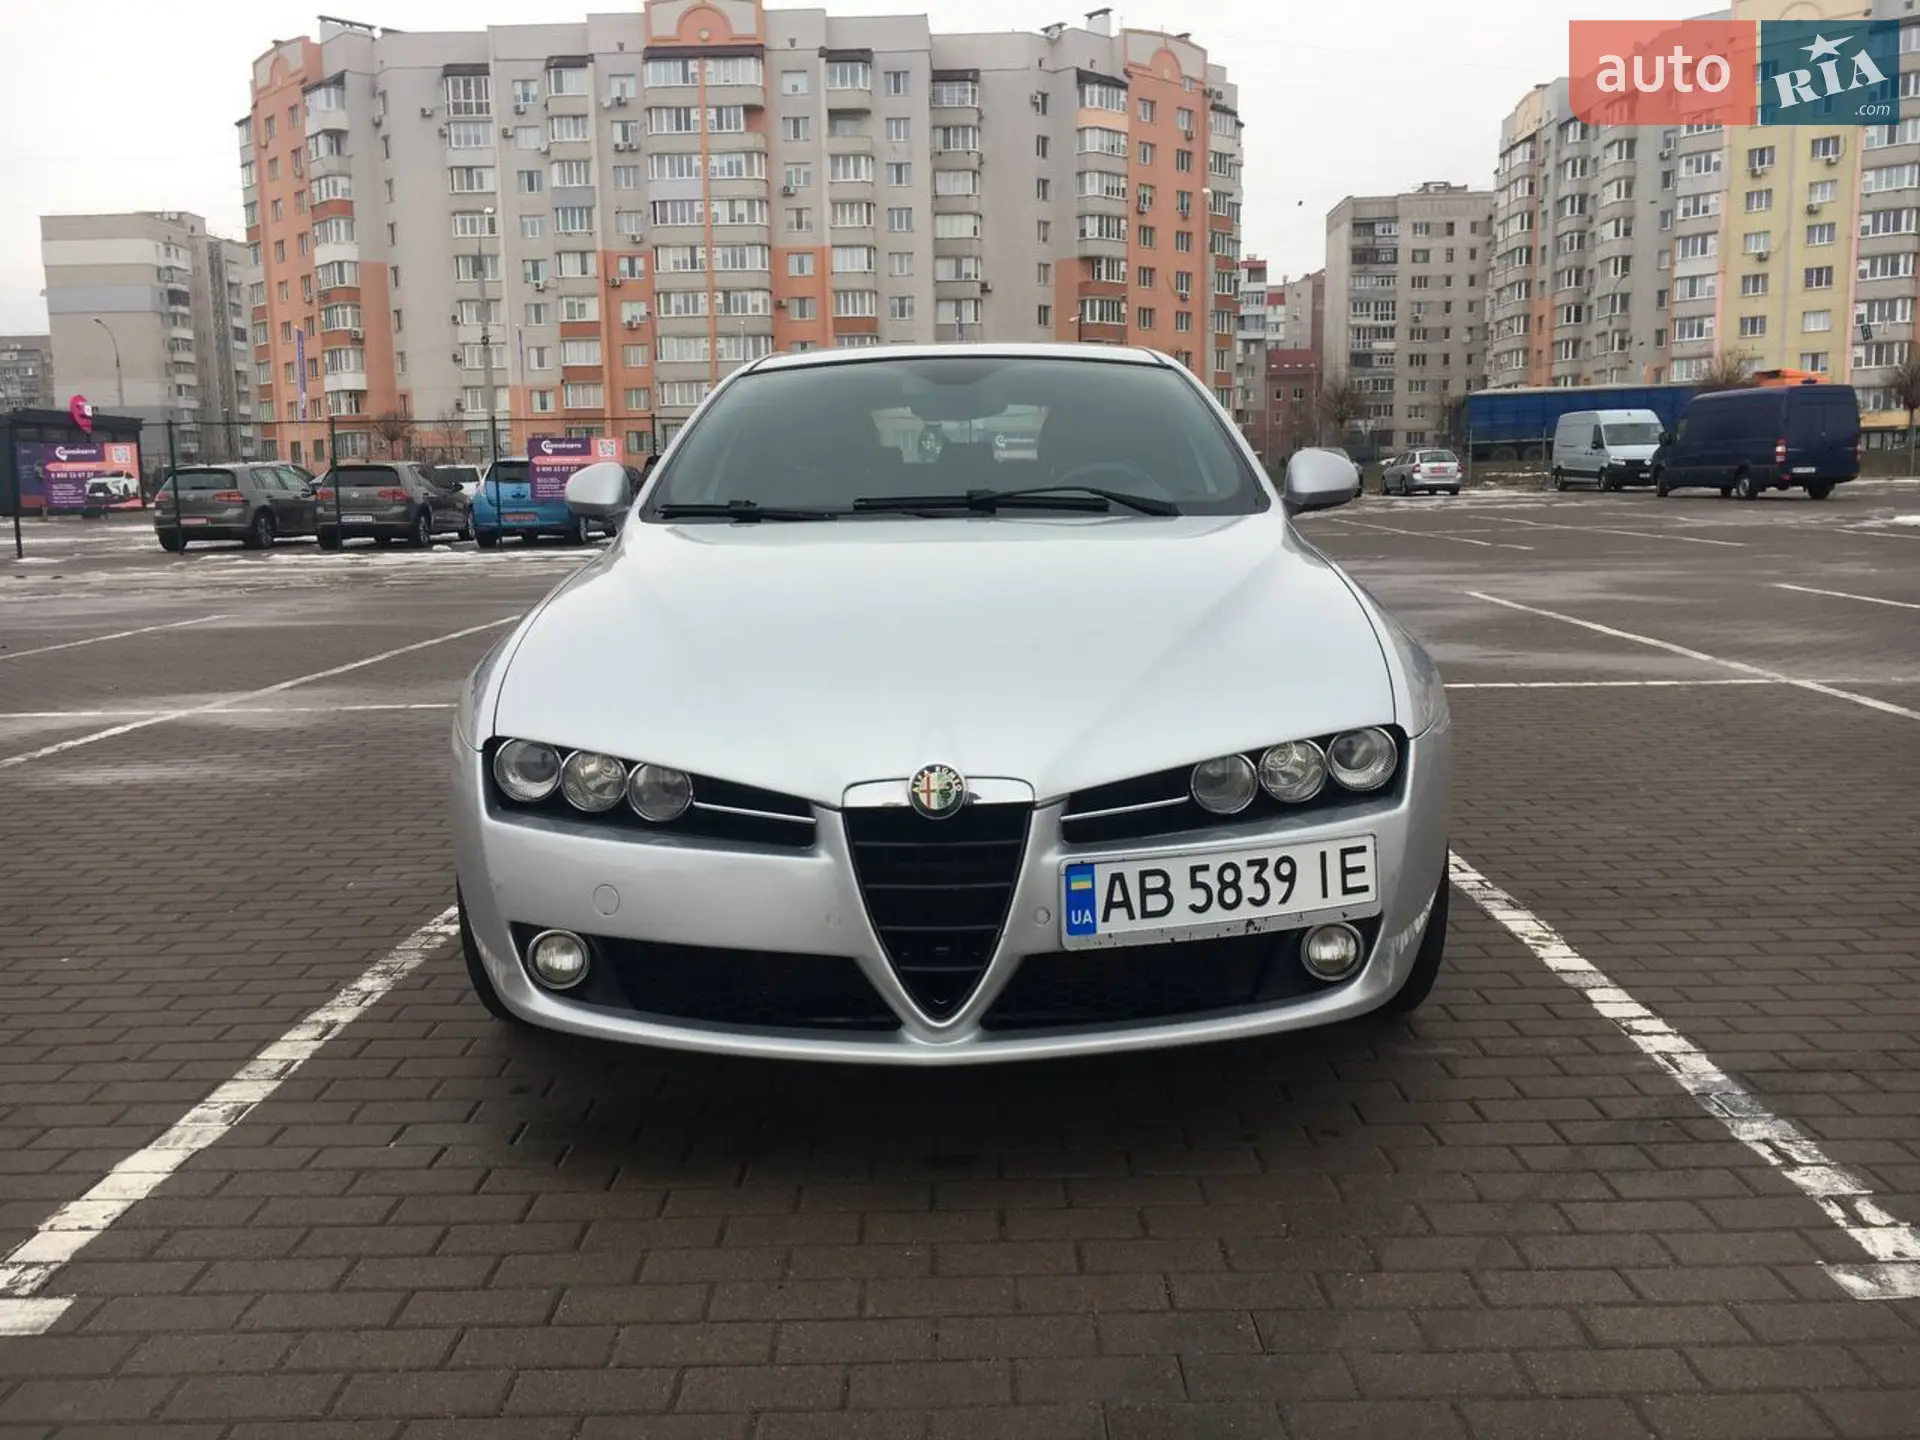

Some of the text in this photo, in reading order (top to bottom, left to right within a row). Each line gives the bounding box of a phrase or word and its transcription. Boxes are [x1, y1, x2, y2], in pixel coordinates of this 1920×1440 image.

[1101, 845, 1370, 923] AB 5839 IE
[1071, 910, 1093, 925] UA
